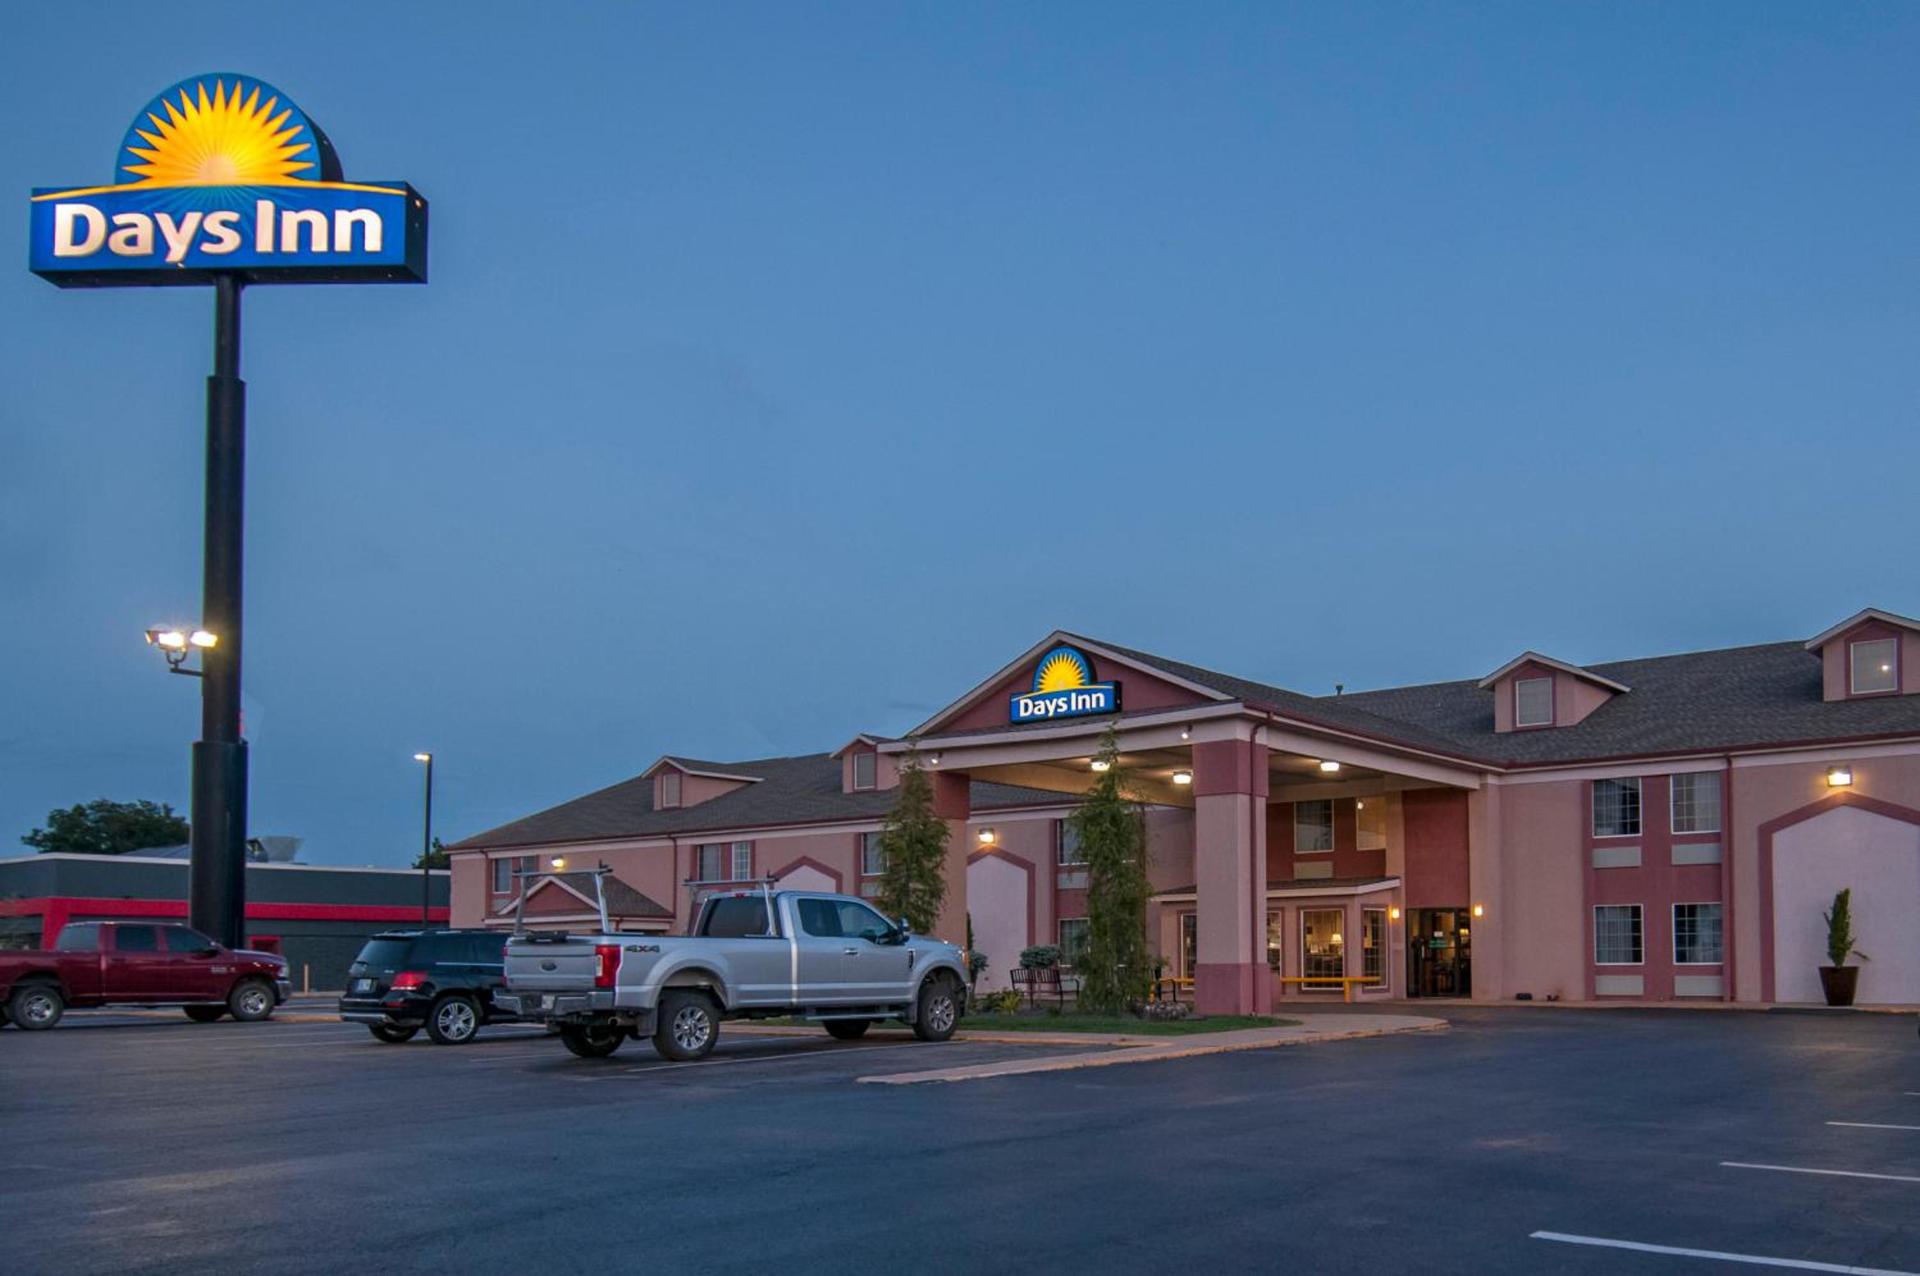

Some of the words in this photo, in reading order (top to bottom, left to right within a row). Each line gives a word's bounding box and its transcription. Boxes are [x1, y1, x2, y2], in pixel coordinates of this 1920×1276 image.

[54, 203, 241, 263] Days
[255, 199, 382, 252] Inn
[1019, 697, 1068, 717] Days
[1071, 692, 1105, 711] Inn
